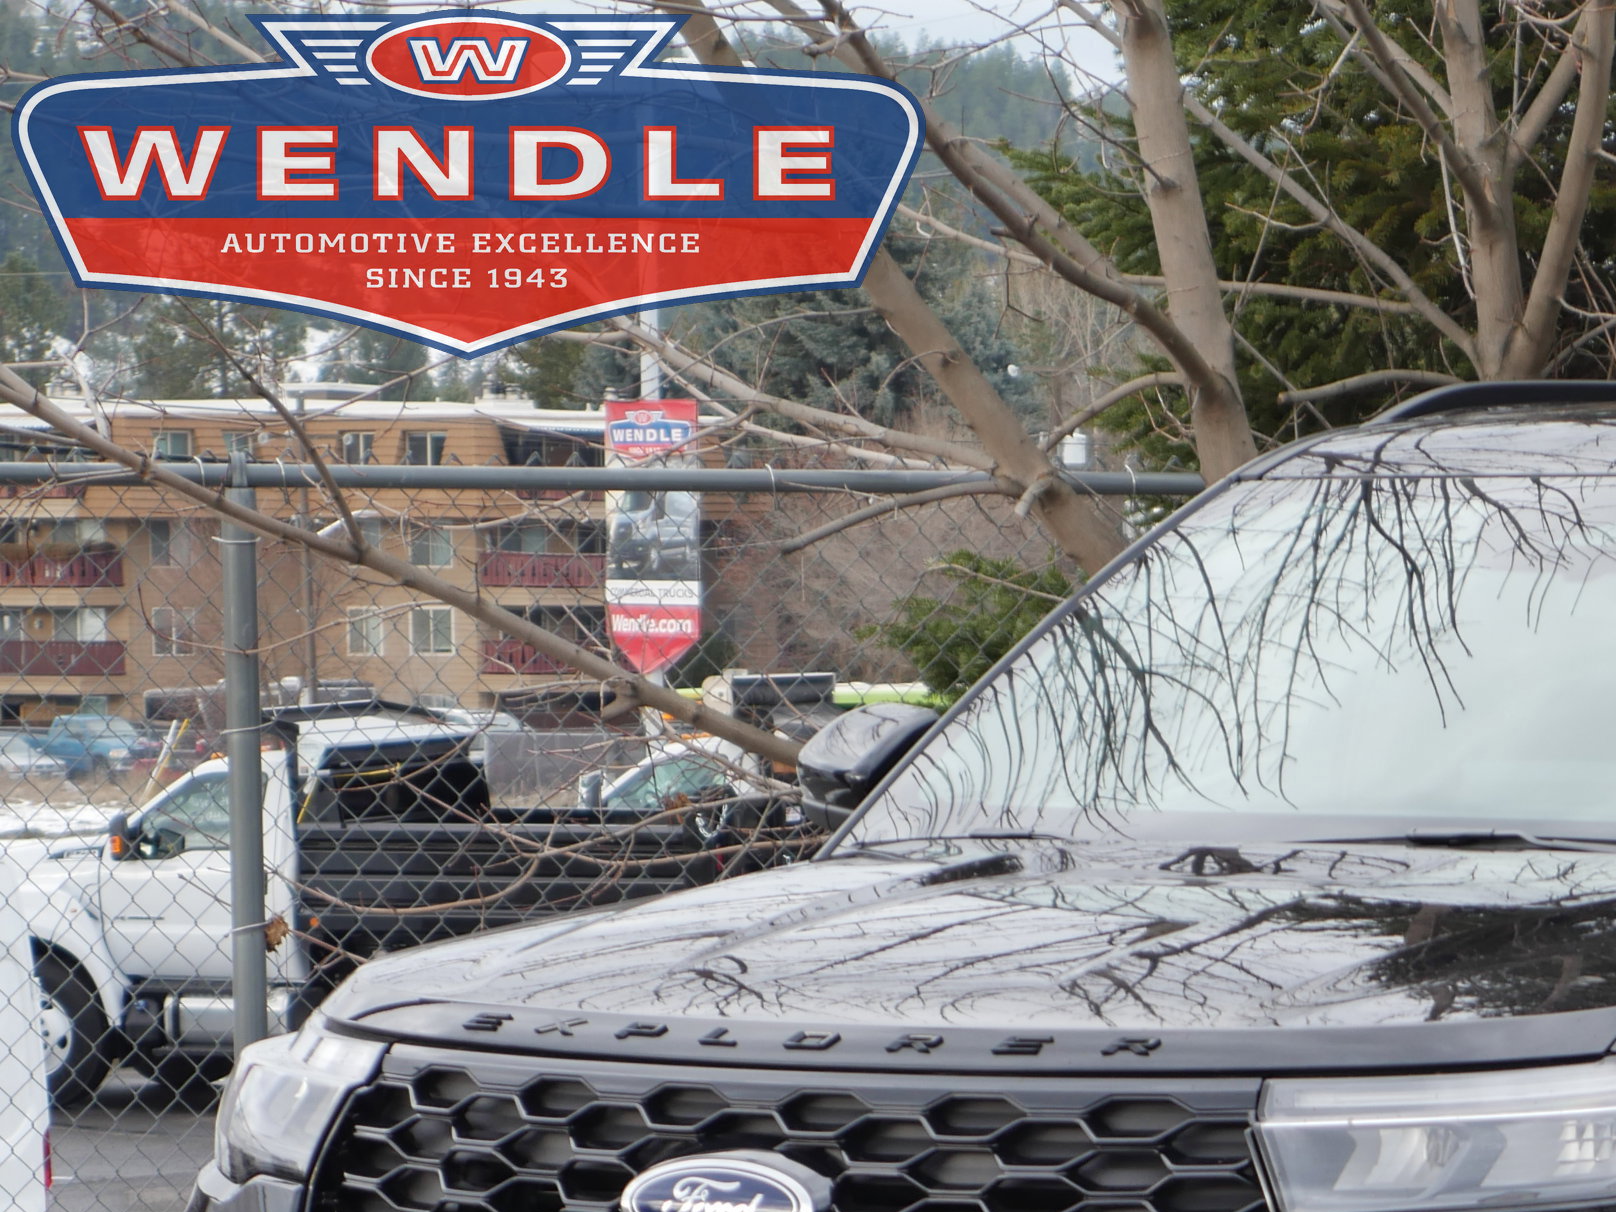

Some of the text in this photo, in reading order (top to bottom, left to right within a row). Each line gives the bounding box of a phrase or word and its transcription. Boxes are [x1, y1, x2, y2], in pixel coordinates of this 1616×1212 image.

[612, 428, 682, 442] WENDLE
[658, 588, 694, 598] TRUCKS
[611, 613, 692, 633] Wendle.com
[462, 1010, 1164, 1058] EXPLORER
